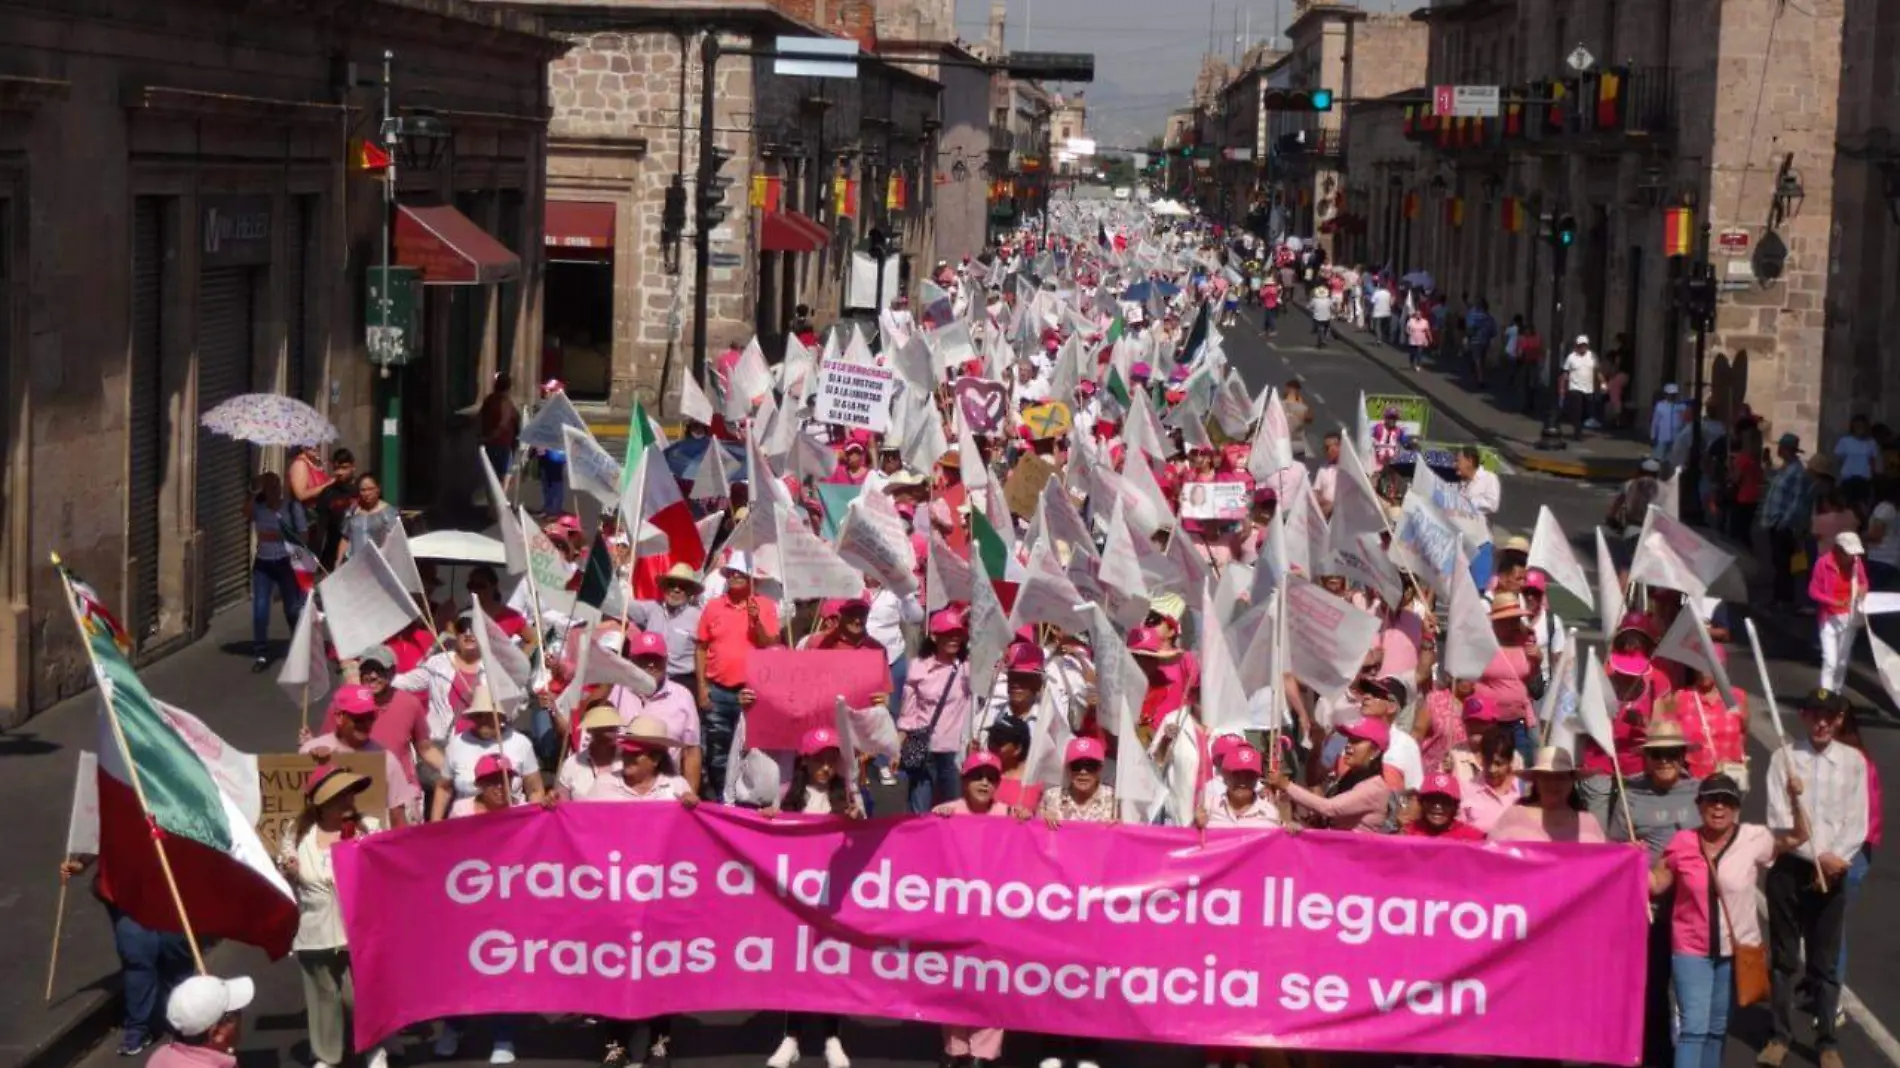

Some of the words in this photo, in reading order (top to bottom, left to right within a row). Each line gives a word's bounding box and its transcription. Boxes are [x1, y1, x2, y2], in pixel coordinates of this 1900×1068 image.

[847, 364, 892, 380] DEMOCRACIA
[852, 378, 883, 390] JUSTICIA
[849, 389, 882, 402] LIBERTAD
[857, 403, 870, 413] PAZ
[446, 850, 697, 904] Gracias
[716, 861, 755, 895] a
[777, 854, 829, 905] la
[850, 857, 1241, 926] democracia
[1263, 877, 1528, 944] llegaron
[468, 929, 717, 980] Gracias
[735, 937, 773, 971] a
[795, 925, 851, 975] la
[871, 936, 1259, 1008] democracia
[1279, 972, 1349, 1013] se
[1368, 977, 1487, 1016] van
